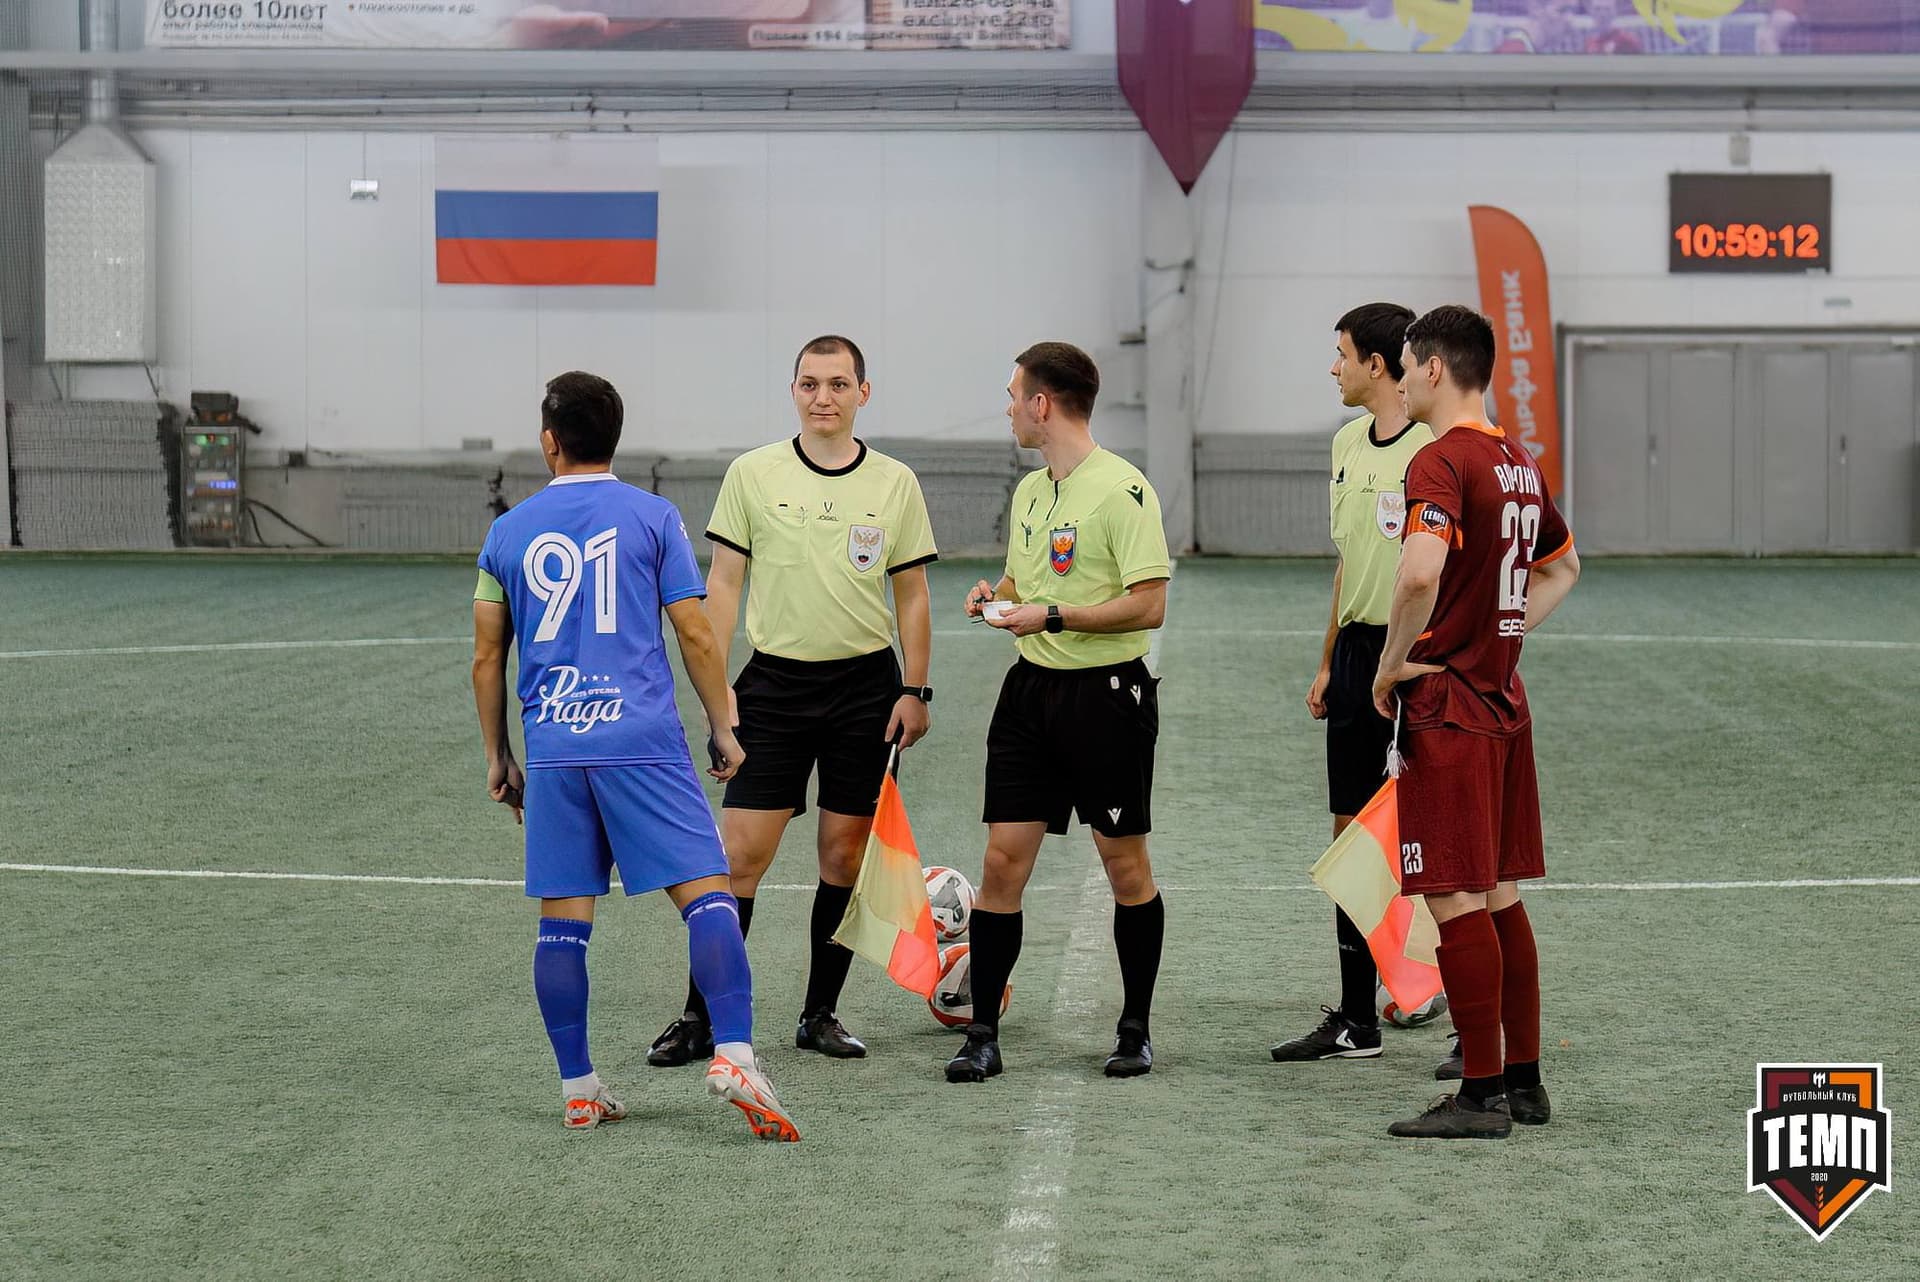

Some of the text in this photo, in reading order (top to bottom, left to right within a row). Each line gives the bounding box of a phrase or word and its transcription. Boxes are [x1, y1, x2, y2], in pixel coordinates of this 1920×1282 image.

[163, 0, 242, 19] более
[1675, 223, 1820, 258] 10:59:12
[523, 527, 618, 643] 91
[536, 665, 625, 734] Praga
[1402, 843, 1423, 874] 23
